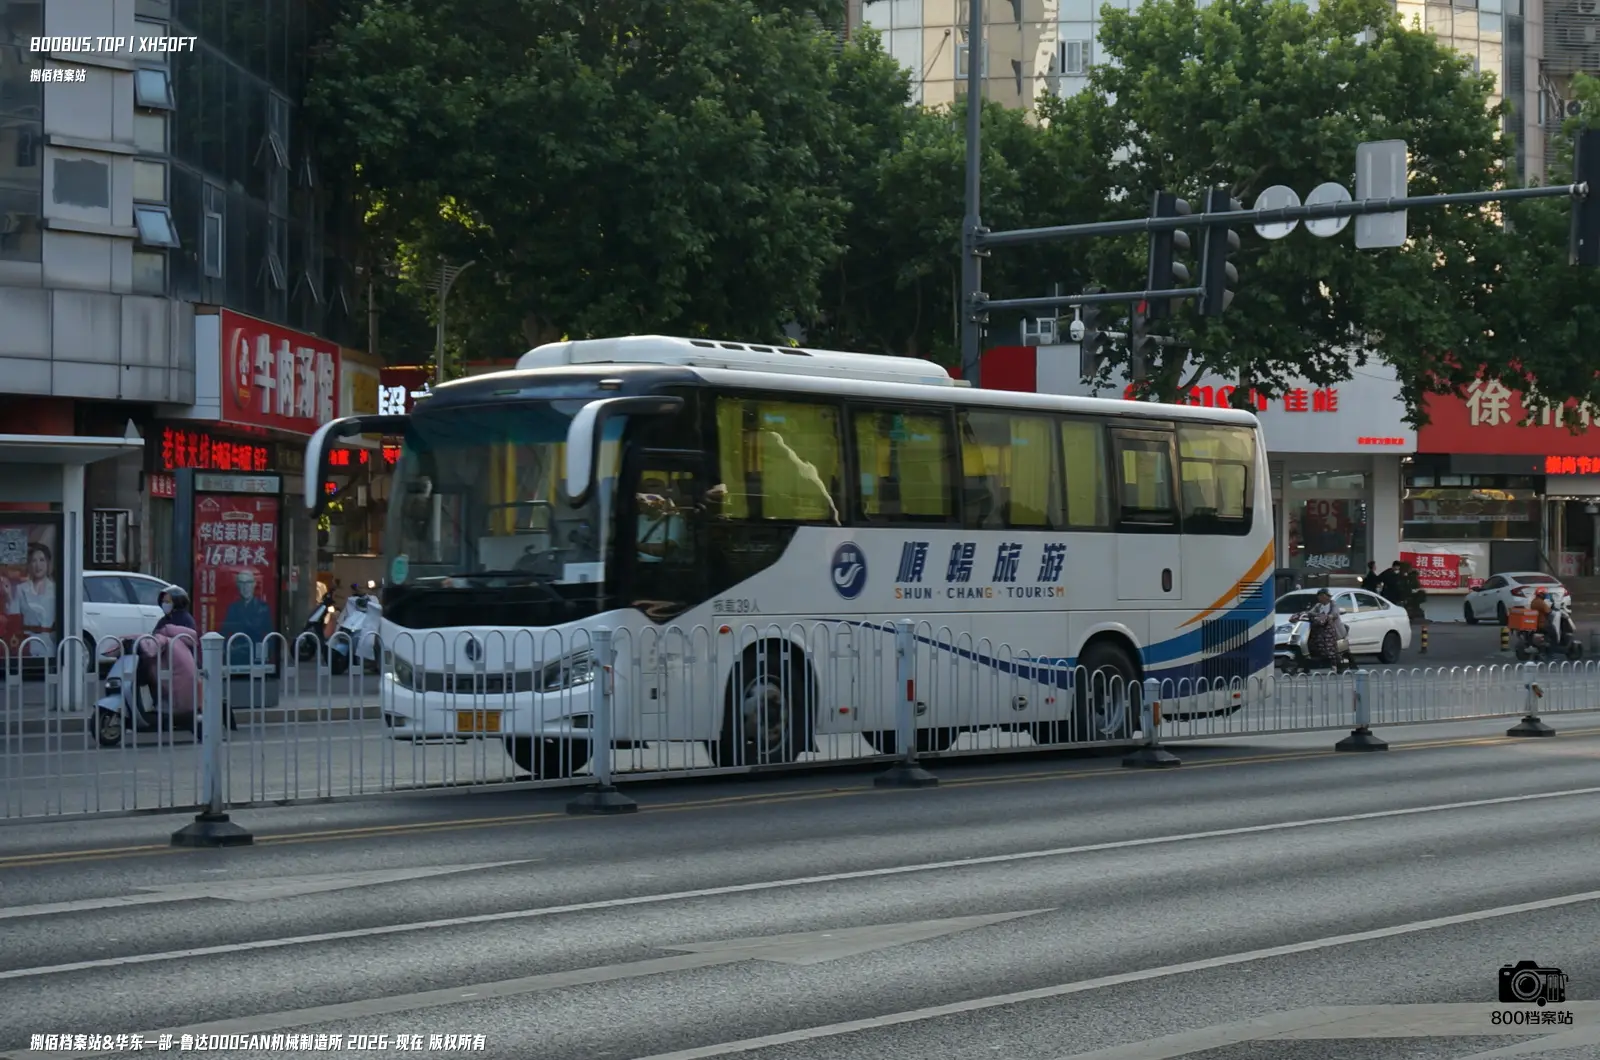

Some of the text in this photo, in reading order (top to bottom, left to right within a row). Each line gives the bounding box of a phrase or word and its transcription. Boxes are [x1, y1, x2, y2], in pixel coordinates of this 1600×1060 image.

[1282, 387, 1338, 412] 佳能
[1306, 500, 1342, 517] EOS
[895, 587, 1065, 599] SHUN CHANG TOURISM
